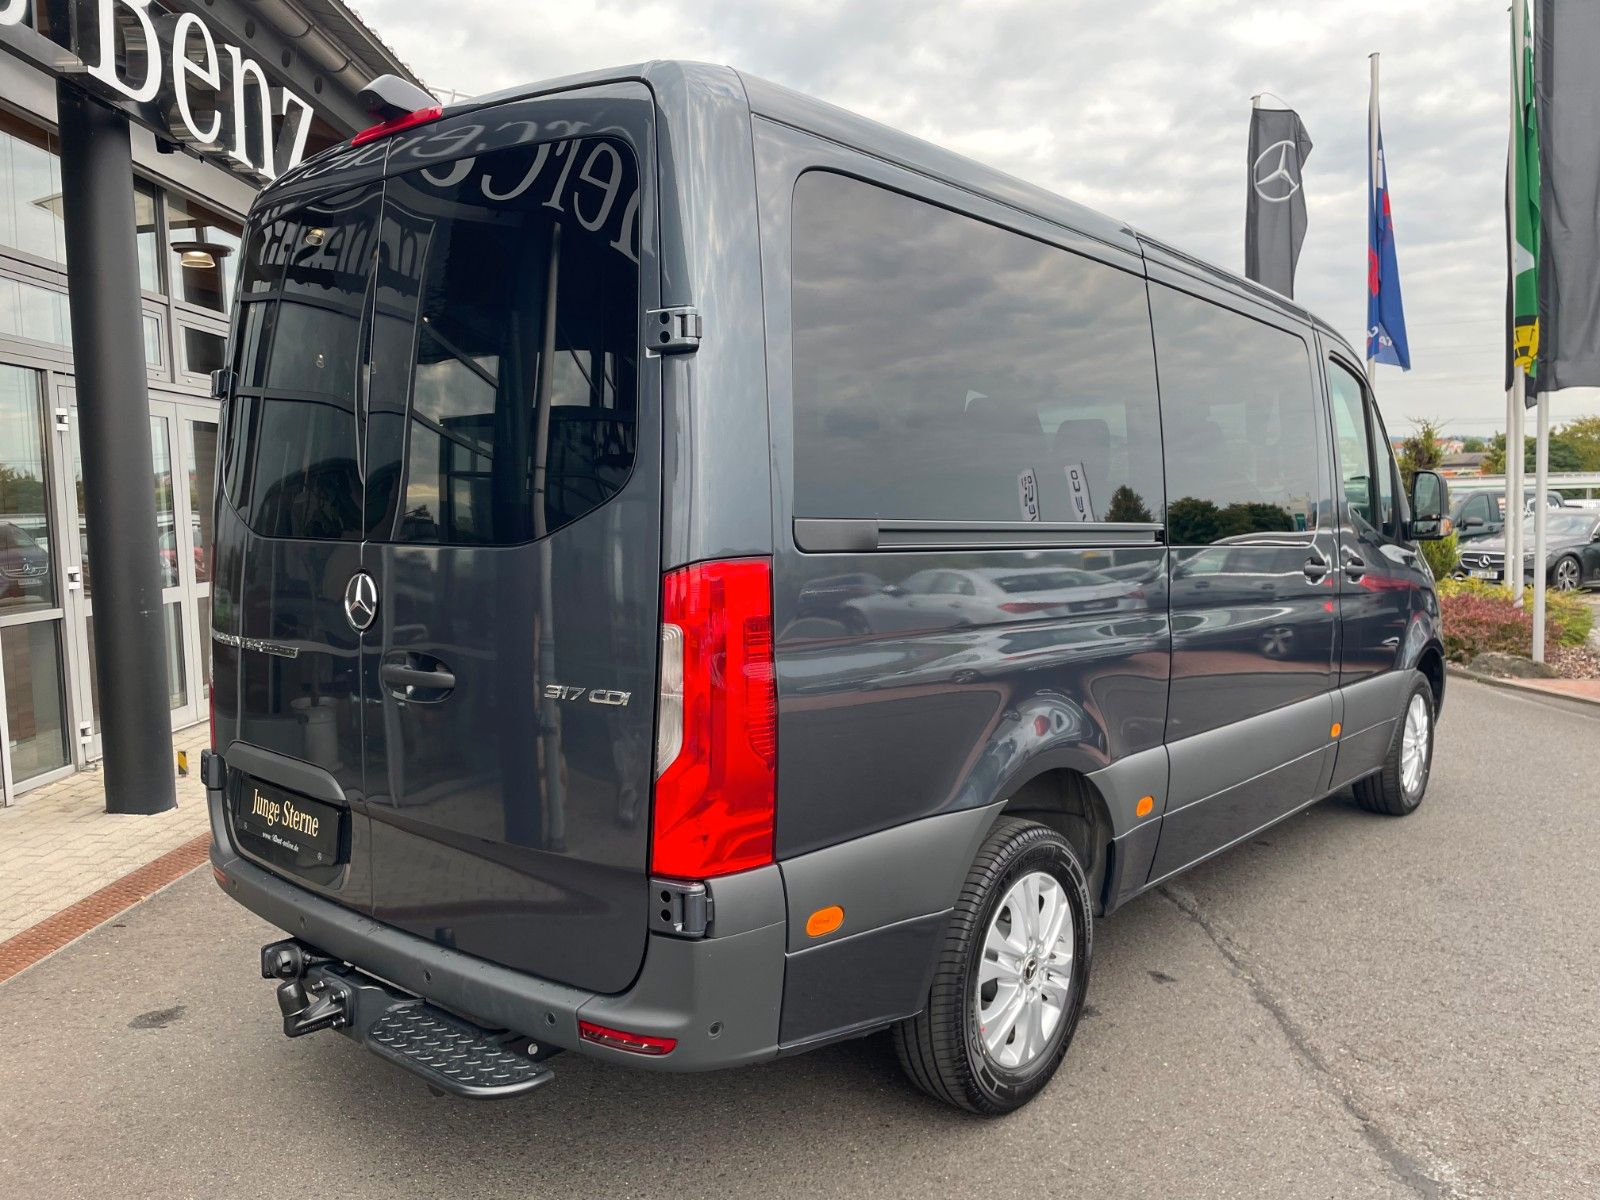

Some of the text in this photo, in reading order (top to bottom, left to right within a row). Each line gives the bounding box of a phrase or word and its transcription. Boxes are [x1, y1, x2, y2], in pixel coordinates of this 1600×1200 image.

[543, 684, 632, 706] 317 CDI
[251, 788, 319, 837] Junge Sterne
